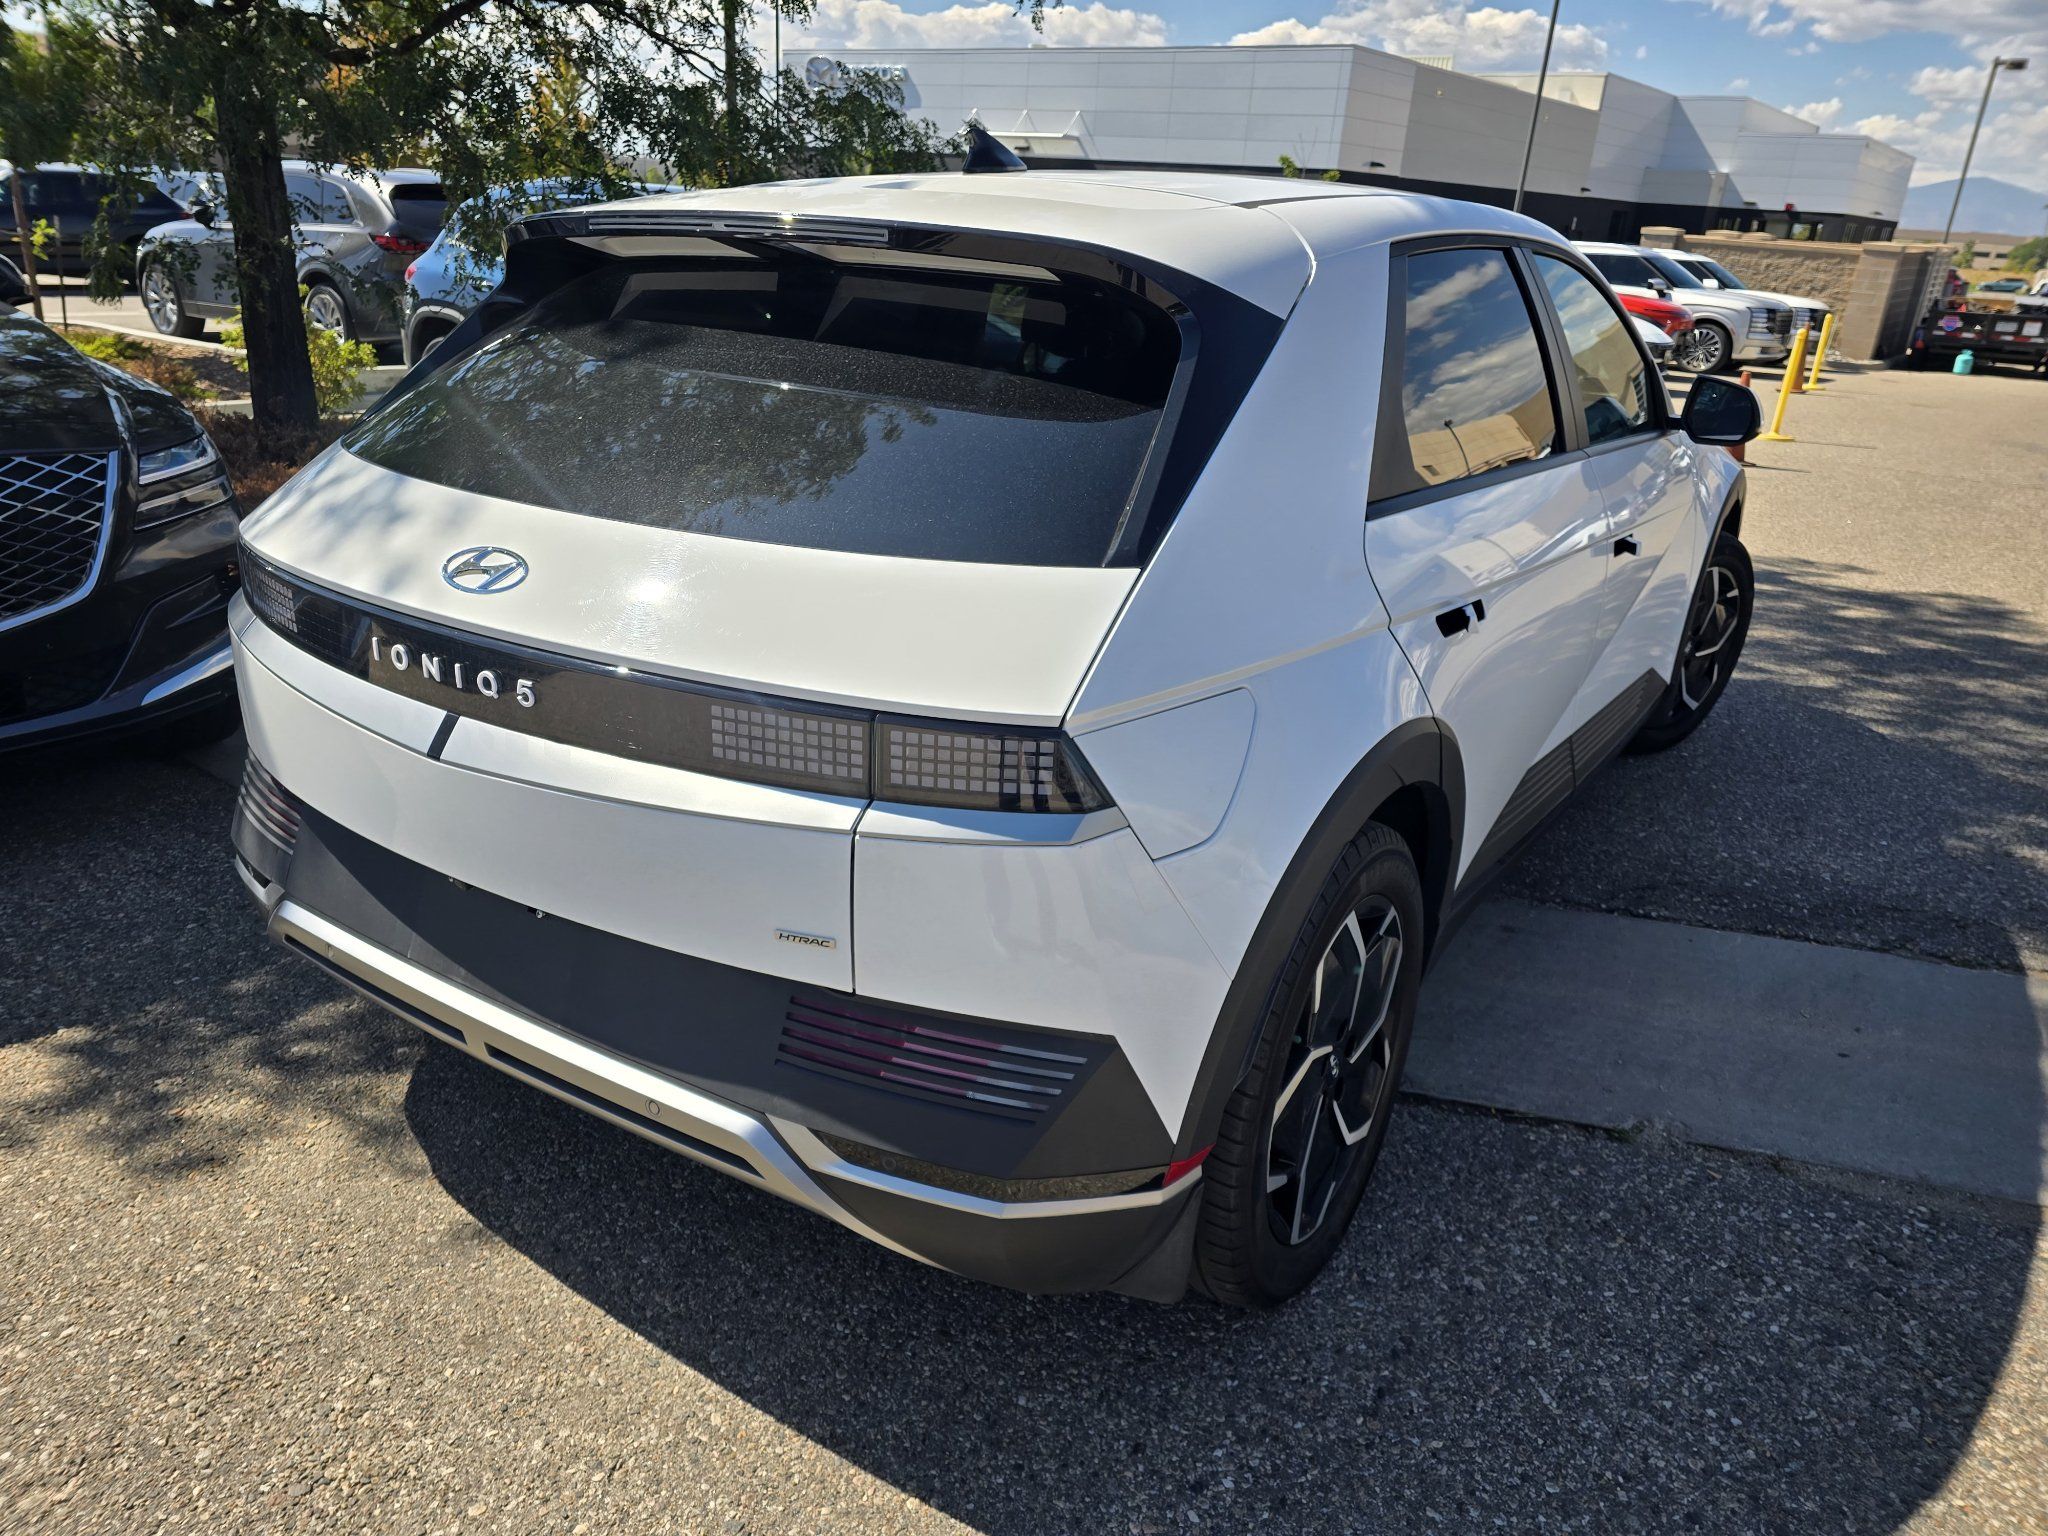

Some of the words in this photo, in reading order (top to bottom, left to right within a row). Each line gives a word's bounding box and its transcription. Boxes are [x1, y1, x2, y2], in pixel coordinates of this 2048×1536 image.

[371, 636, 499, 700] IONIQ
[516, 678, 536, 708] 5
[778, 932, 831, 948] HTRAC
